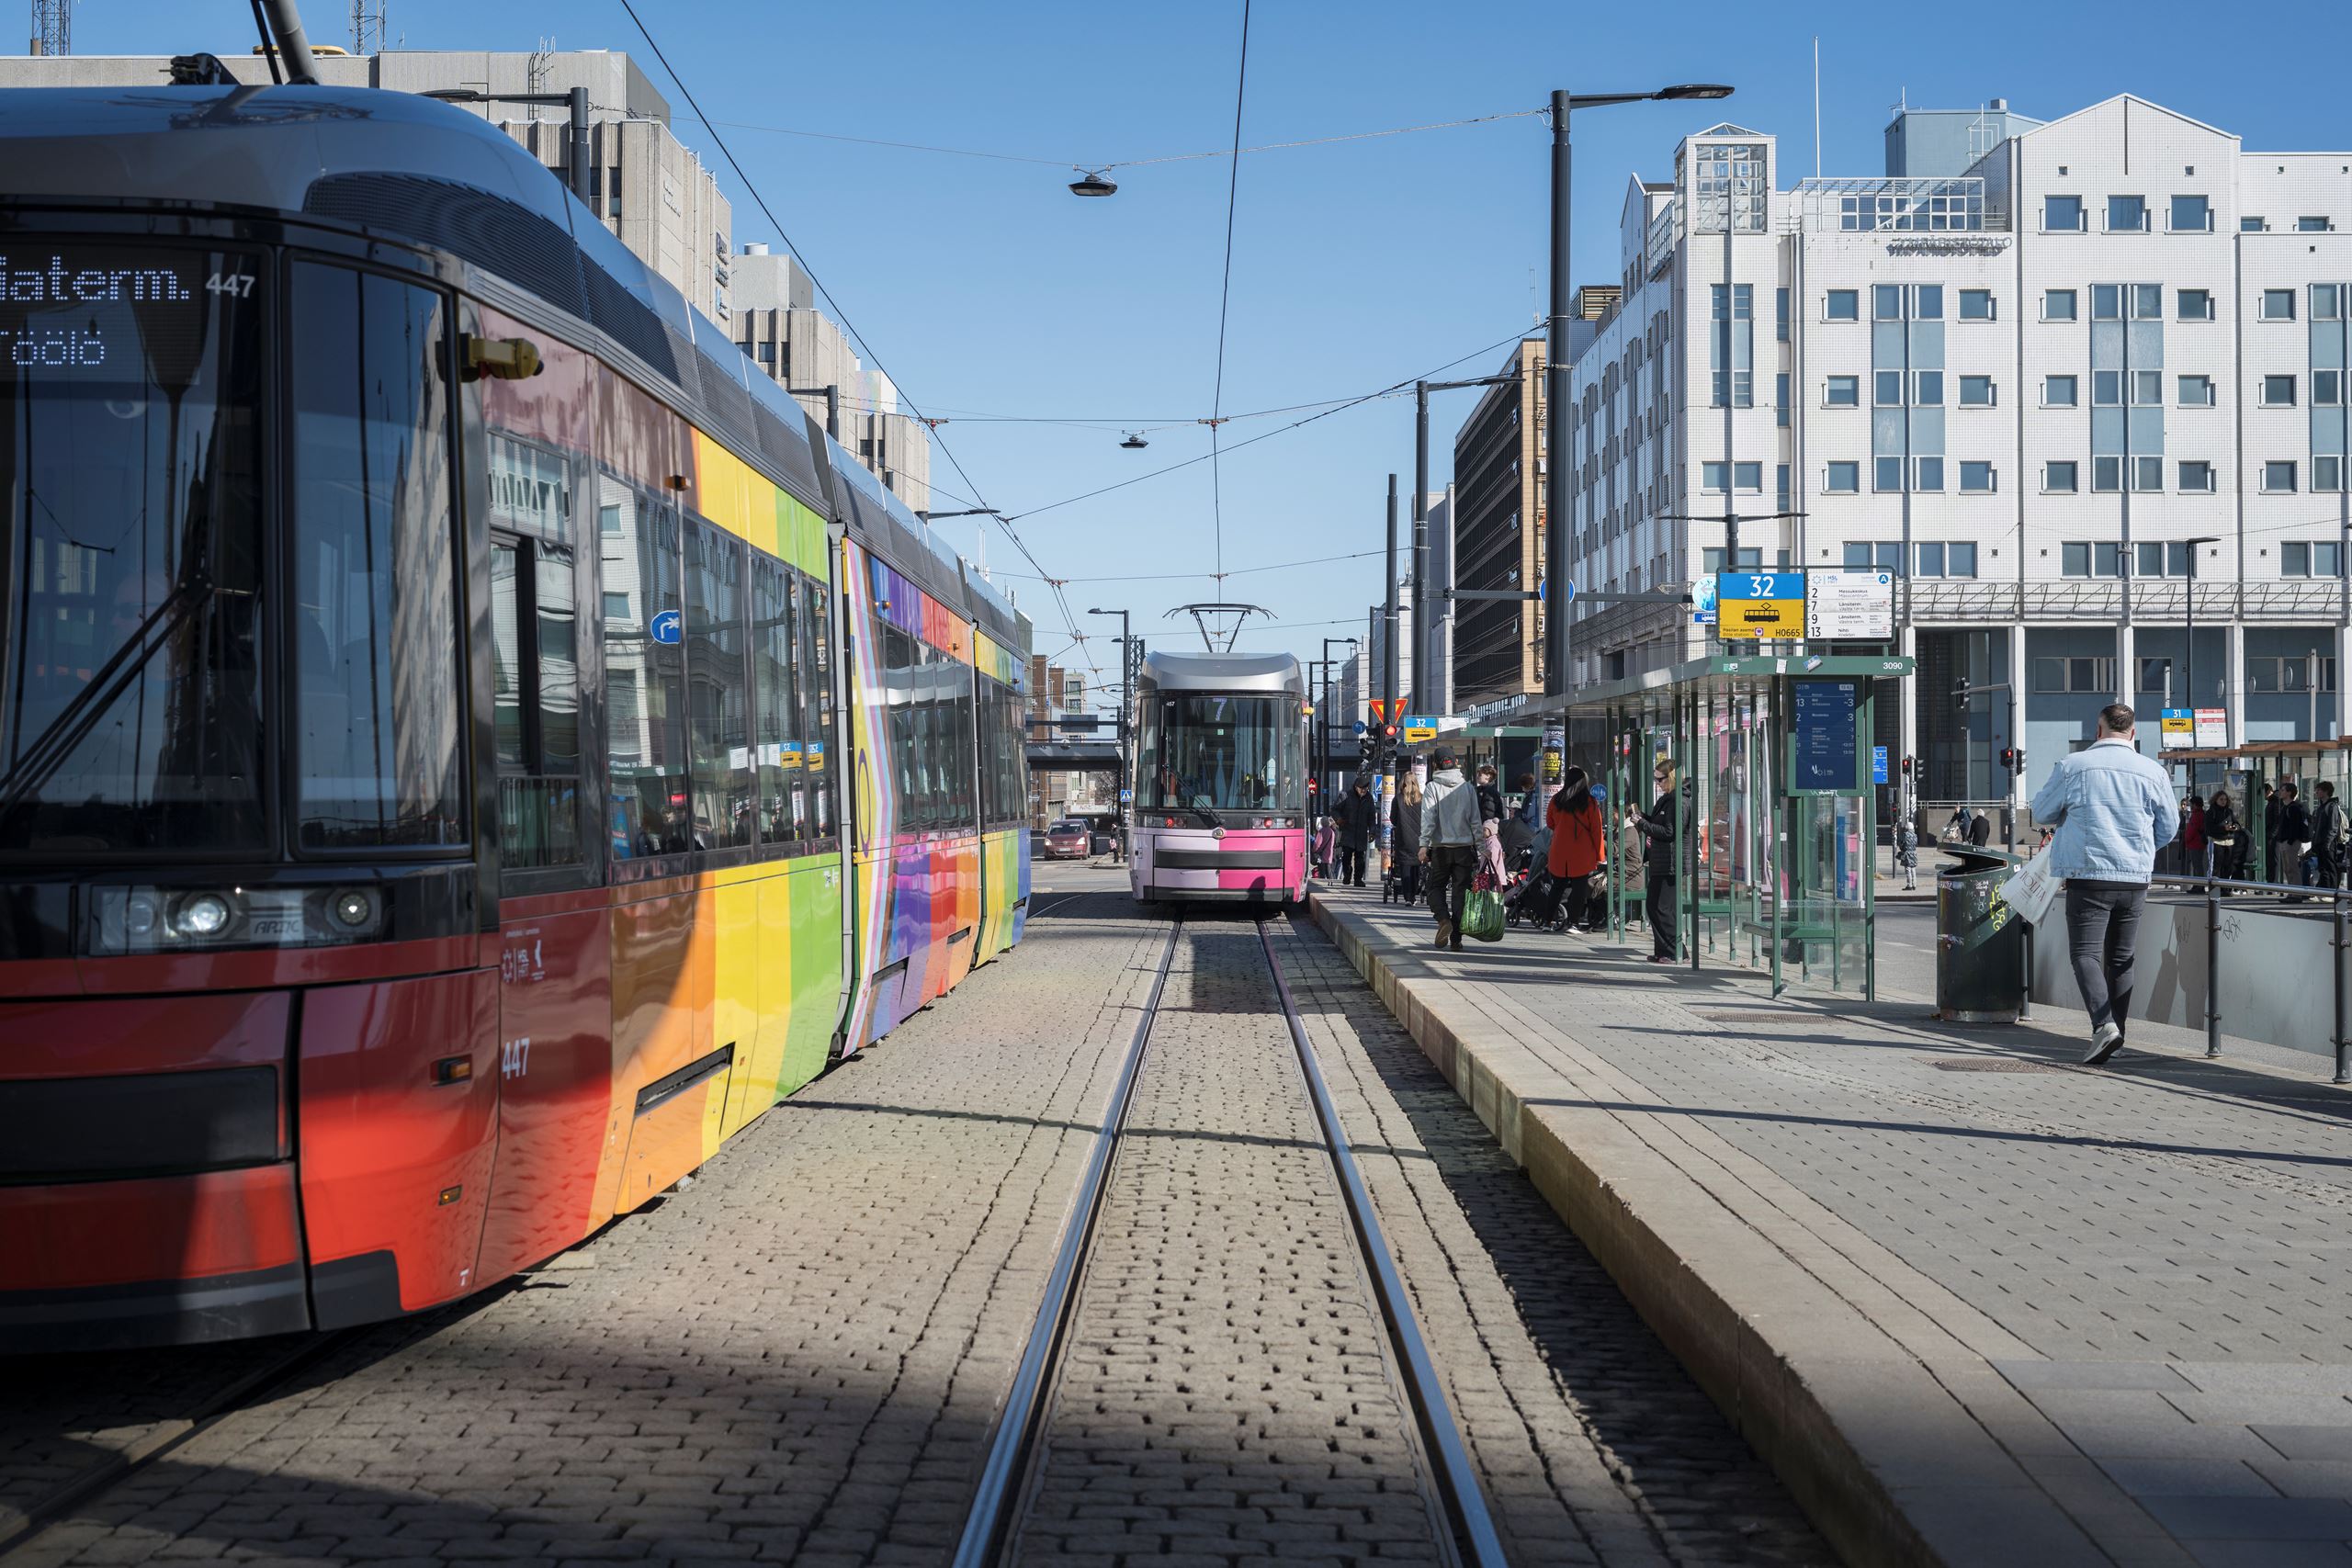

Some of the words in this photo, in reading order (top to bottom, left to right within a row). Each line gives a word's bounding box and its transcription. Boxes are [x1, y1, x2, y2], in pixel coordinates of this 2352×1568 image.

[205, 272, 255, 298] 447
[1749, 575, 1775, 597] 32
[1812, 587, 1818, 598] 2
[1811, 601, 1817, 611] 7
[1811, 614, 1818, 625] 9
[1775, 628, 1801, 637] H0665
[1811, 626, 1821, 637] 13
[1883, 661, 1903, 670] 3090
[1795, 698, 1804, 707] 13
[1213, 697, 1227, 722] 7
[2173, 709, 2182, 718] 31
[1416, 718, 1426, 728] 32
[1796, 713, 1802, 722] 2
[1848, 713, 1854, 722] 3
[253, 919, 300, 934] ARTIC
[502, 1037, 530, 1080] 447
